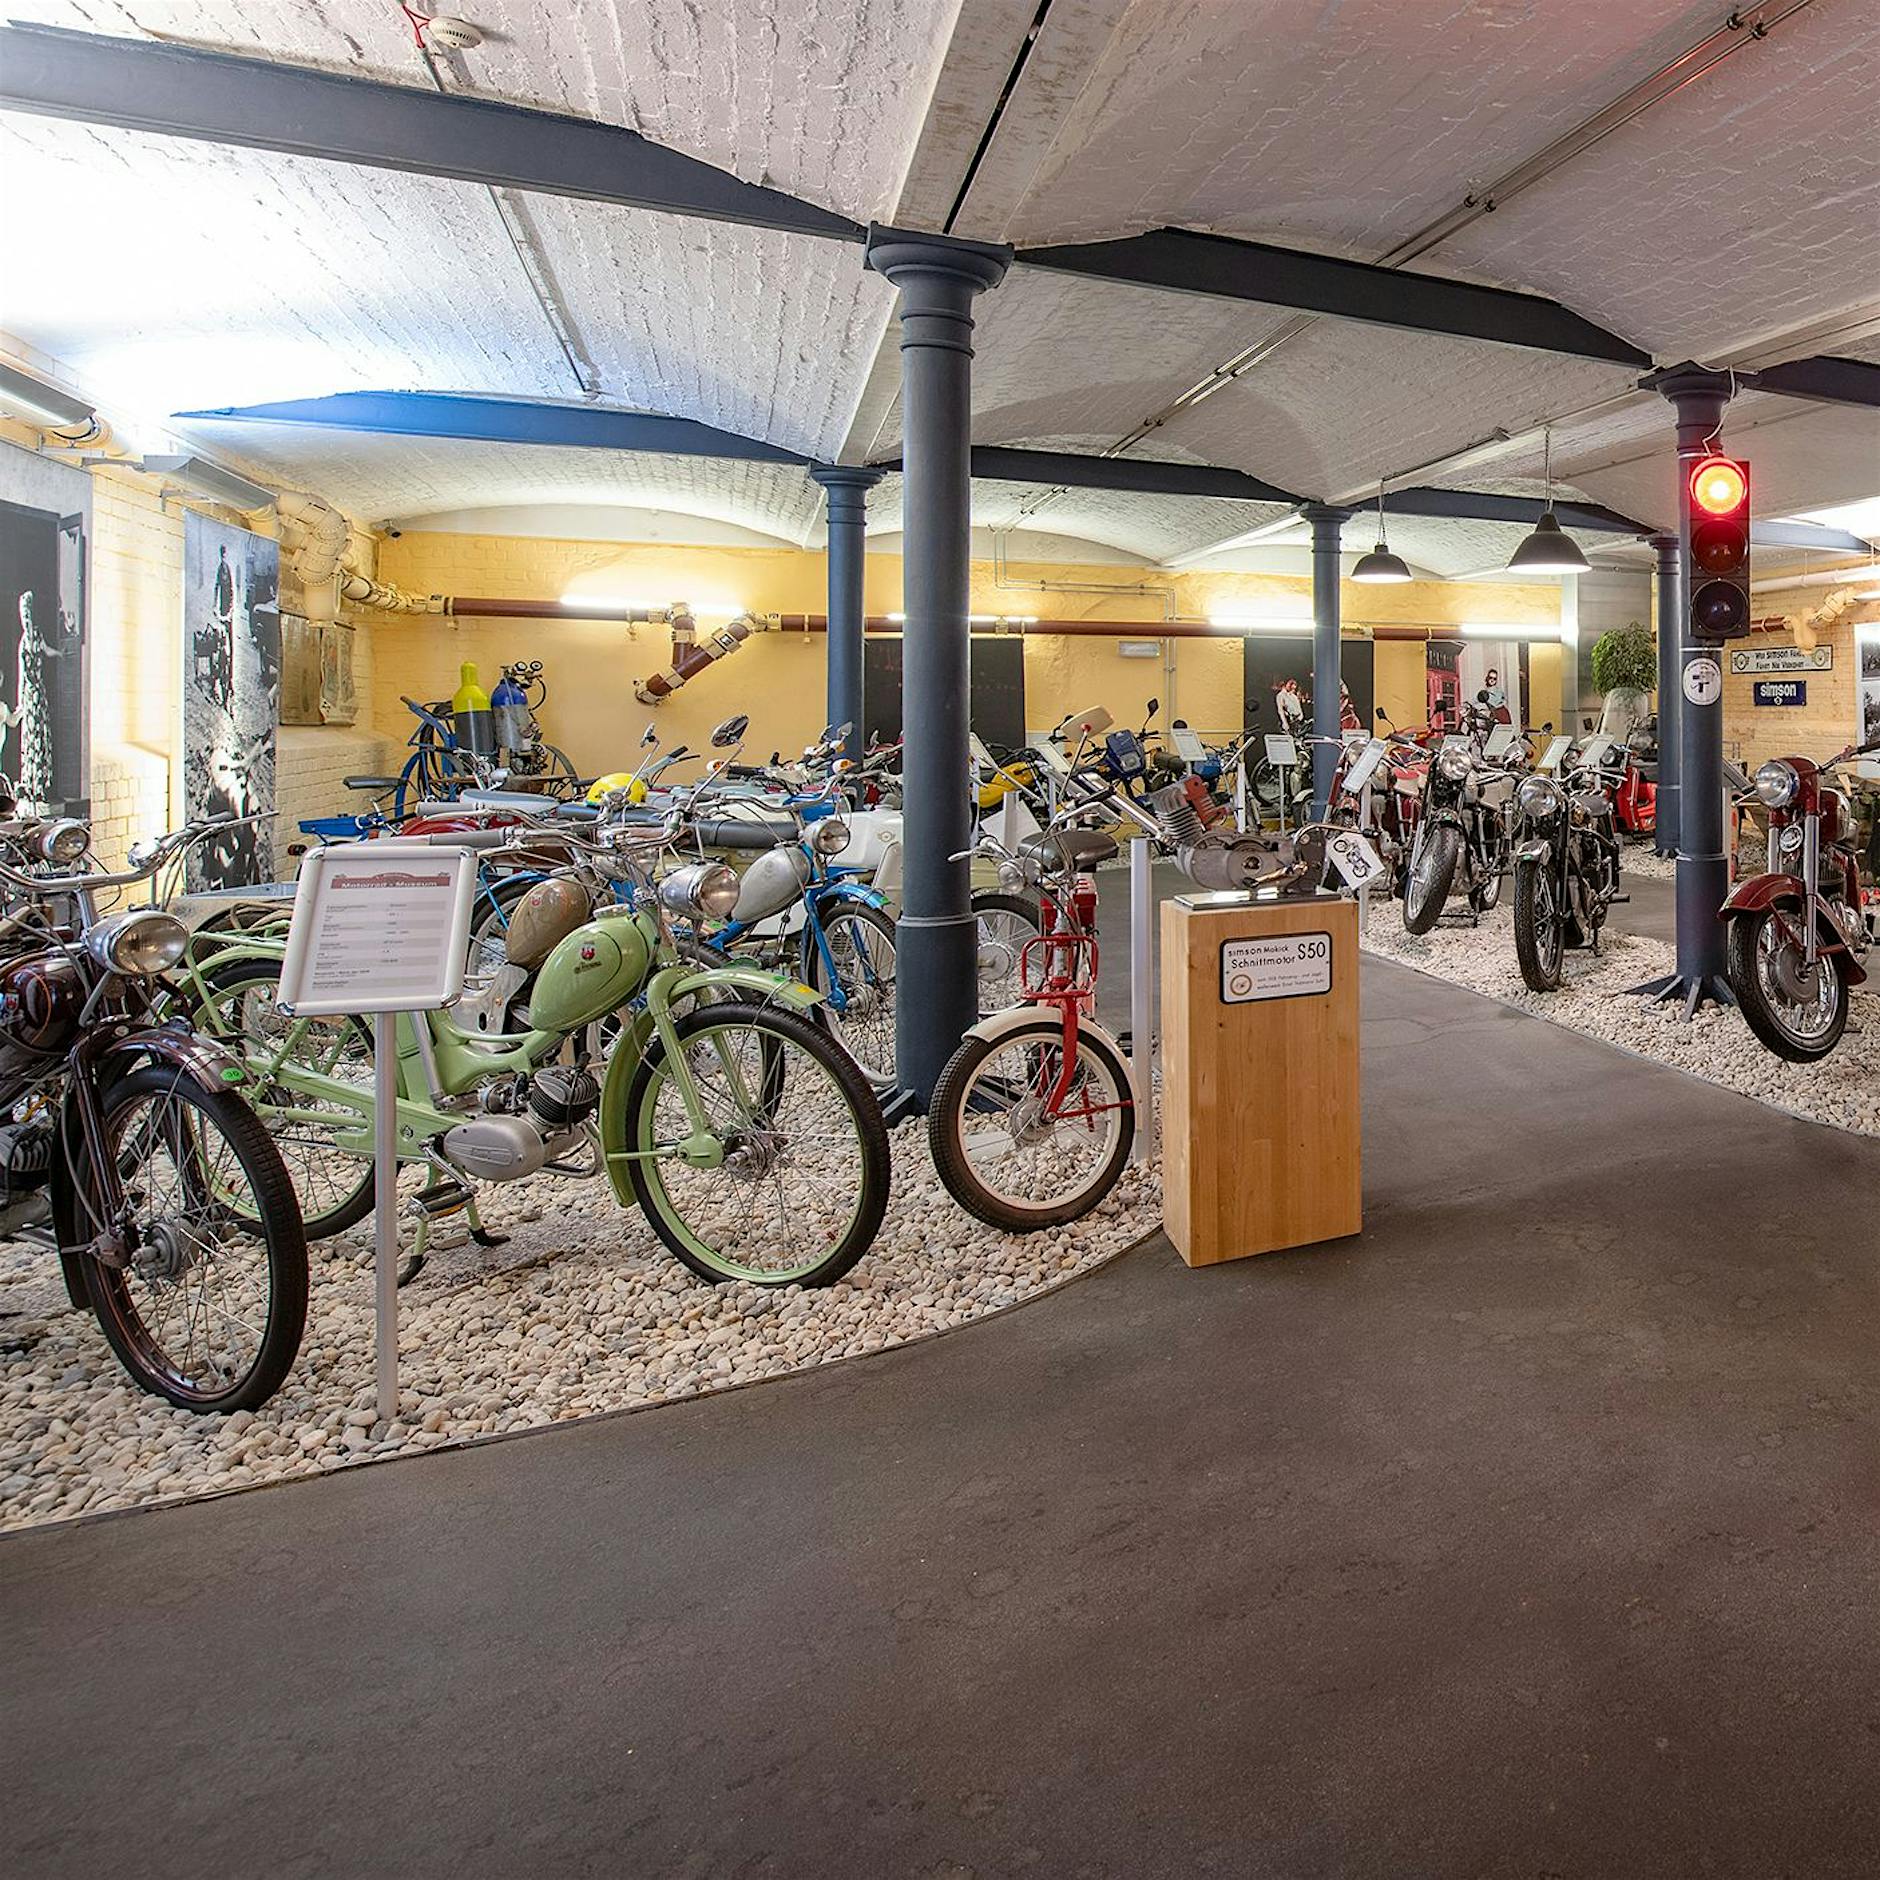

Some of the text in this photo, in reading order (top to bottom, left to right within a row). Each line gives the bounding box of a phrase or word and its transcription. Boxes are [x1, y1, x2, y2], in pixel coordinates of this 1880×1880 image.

[1760, 682, 1797, 697] simson
[1228, 941, 1326, 960] simson Mokick S50
[1231, 956, 1296, 969] Schnittmotor
